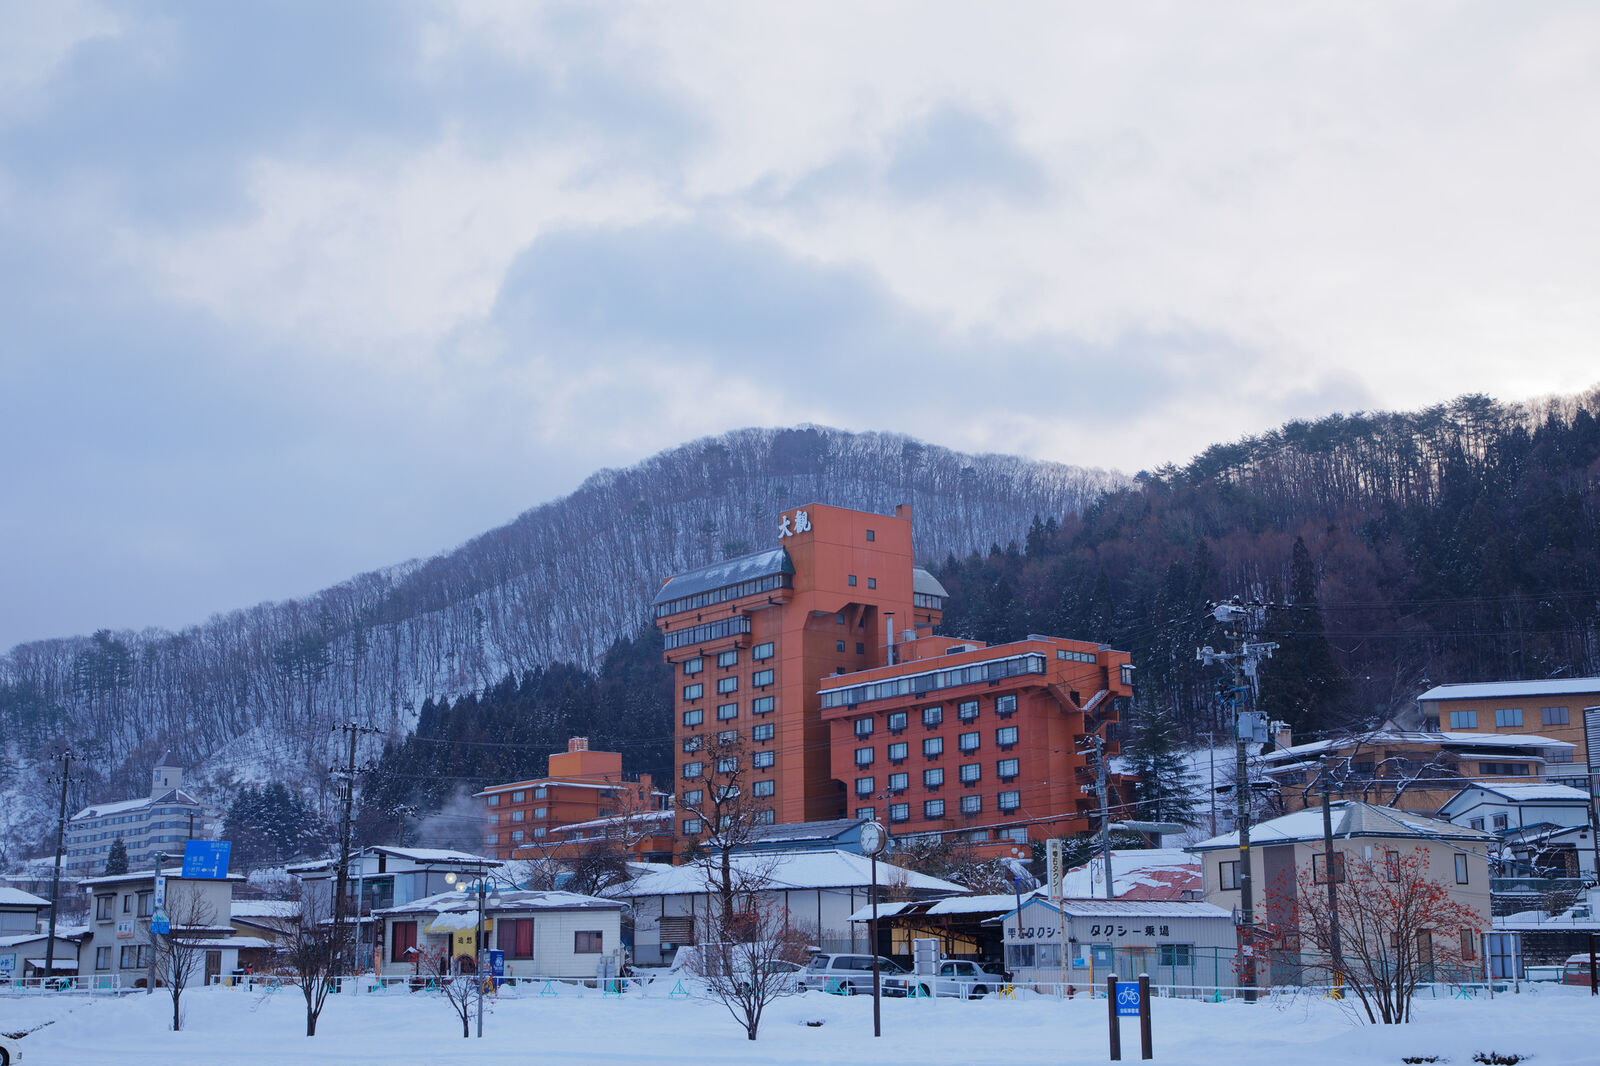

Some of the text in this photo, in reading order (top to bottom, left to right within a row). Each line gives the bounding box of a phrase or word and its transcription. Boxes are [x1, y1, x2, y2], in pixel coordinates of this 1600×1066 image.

[778, 510, 811, 538] 大観
[1090, 924, 1170, 937] タクシー乗場
